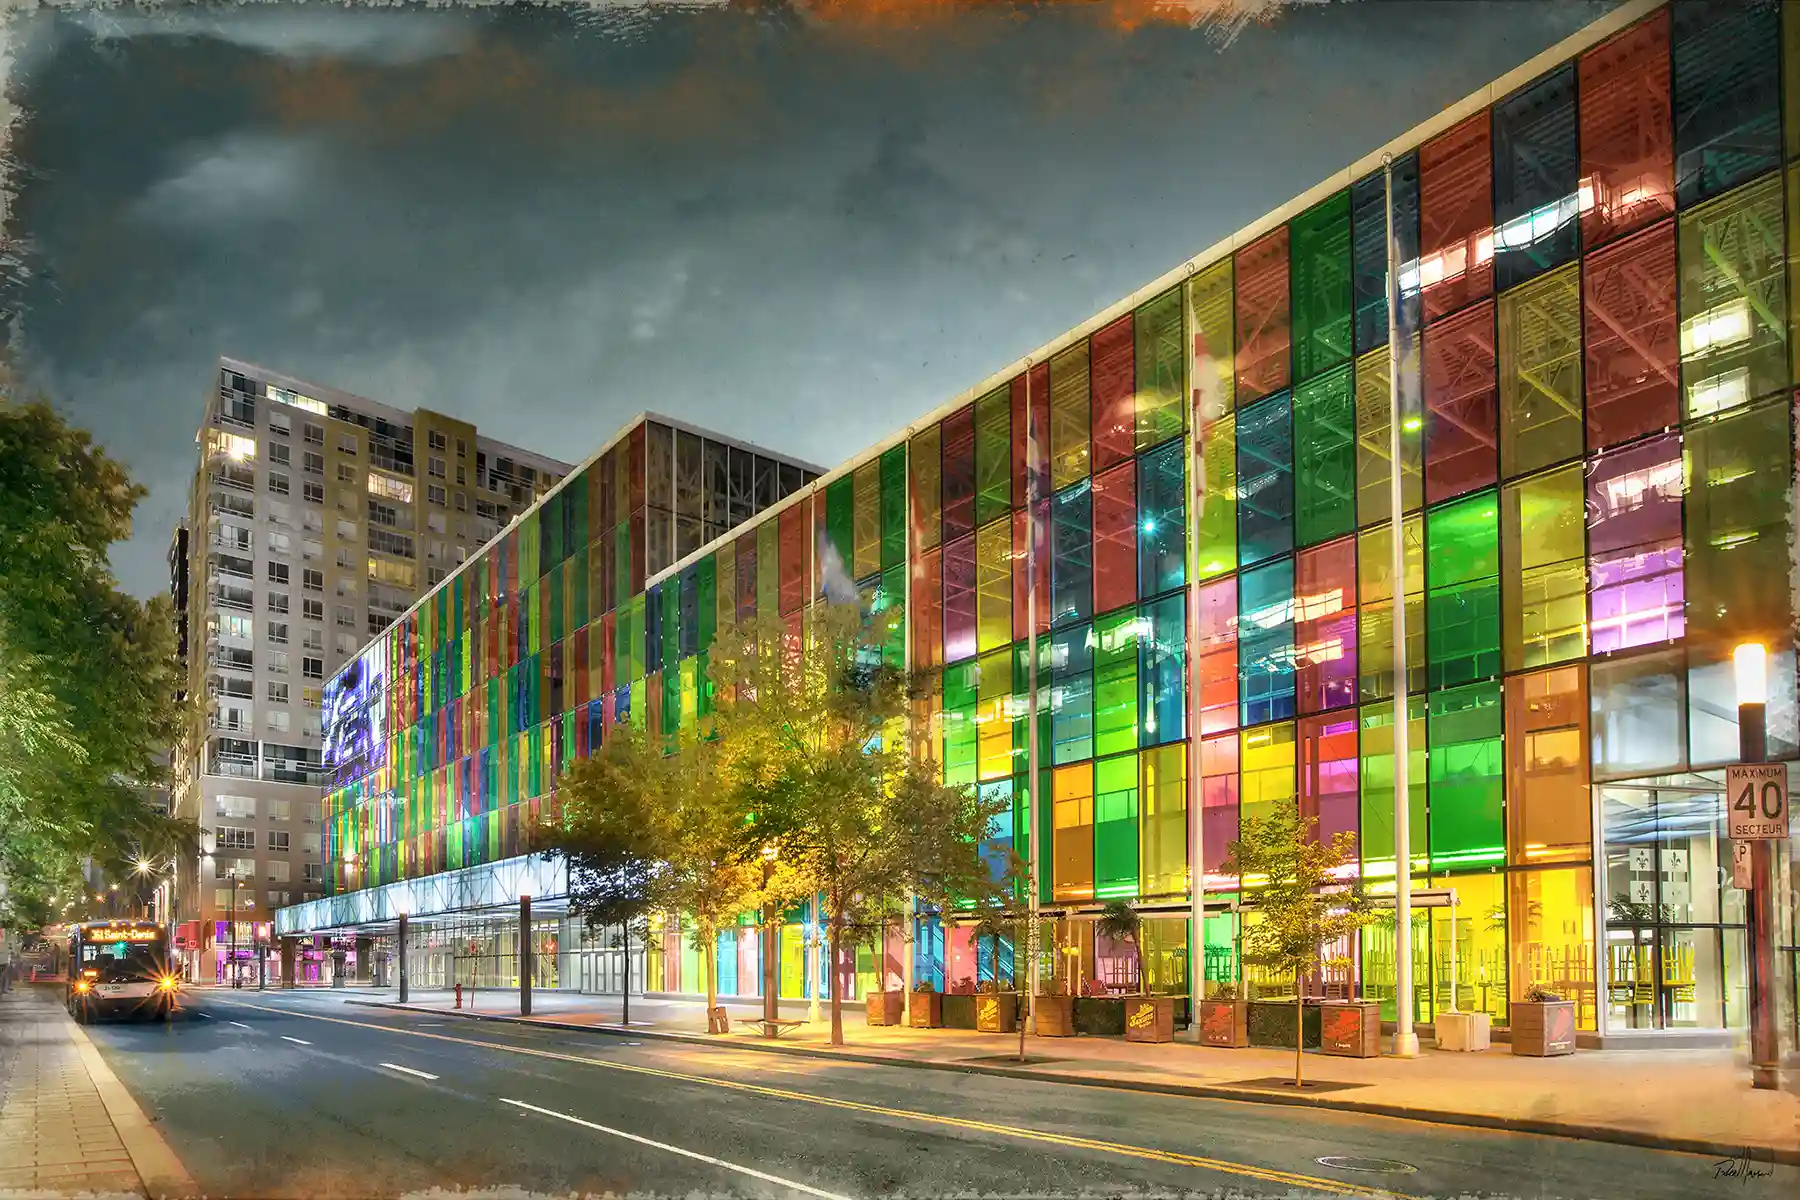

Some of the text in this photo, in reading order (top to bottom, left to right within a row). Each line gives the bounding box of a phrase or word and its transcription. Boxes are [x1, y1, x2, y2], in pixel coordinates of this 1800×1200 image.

[1732, 768, 1781, 780] MAXIMUM
[1734, 781, 1782, 819] 40
[1735, 824, 1782, 835] SECTEUR
